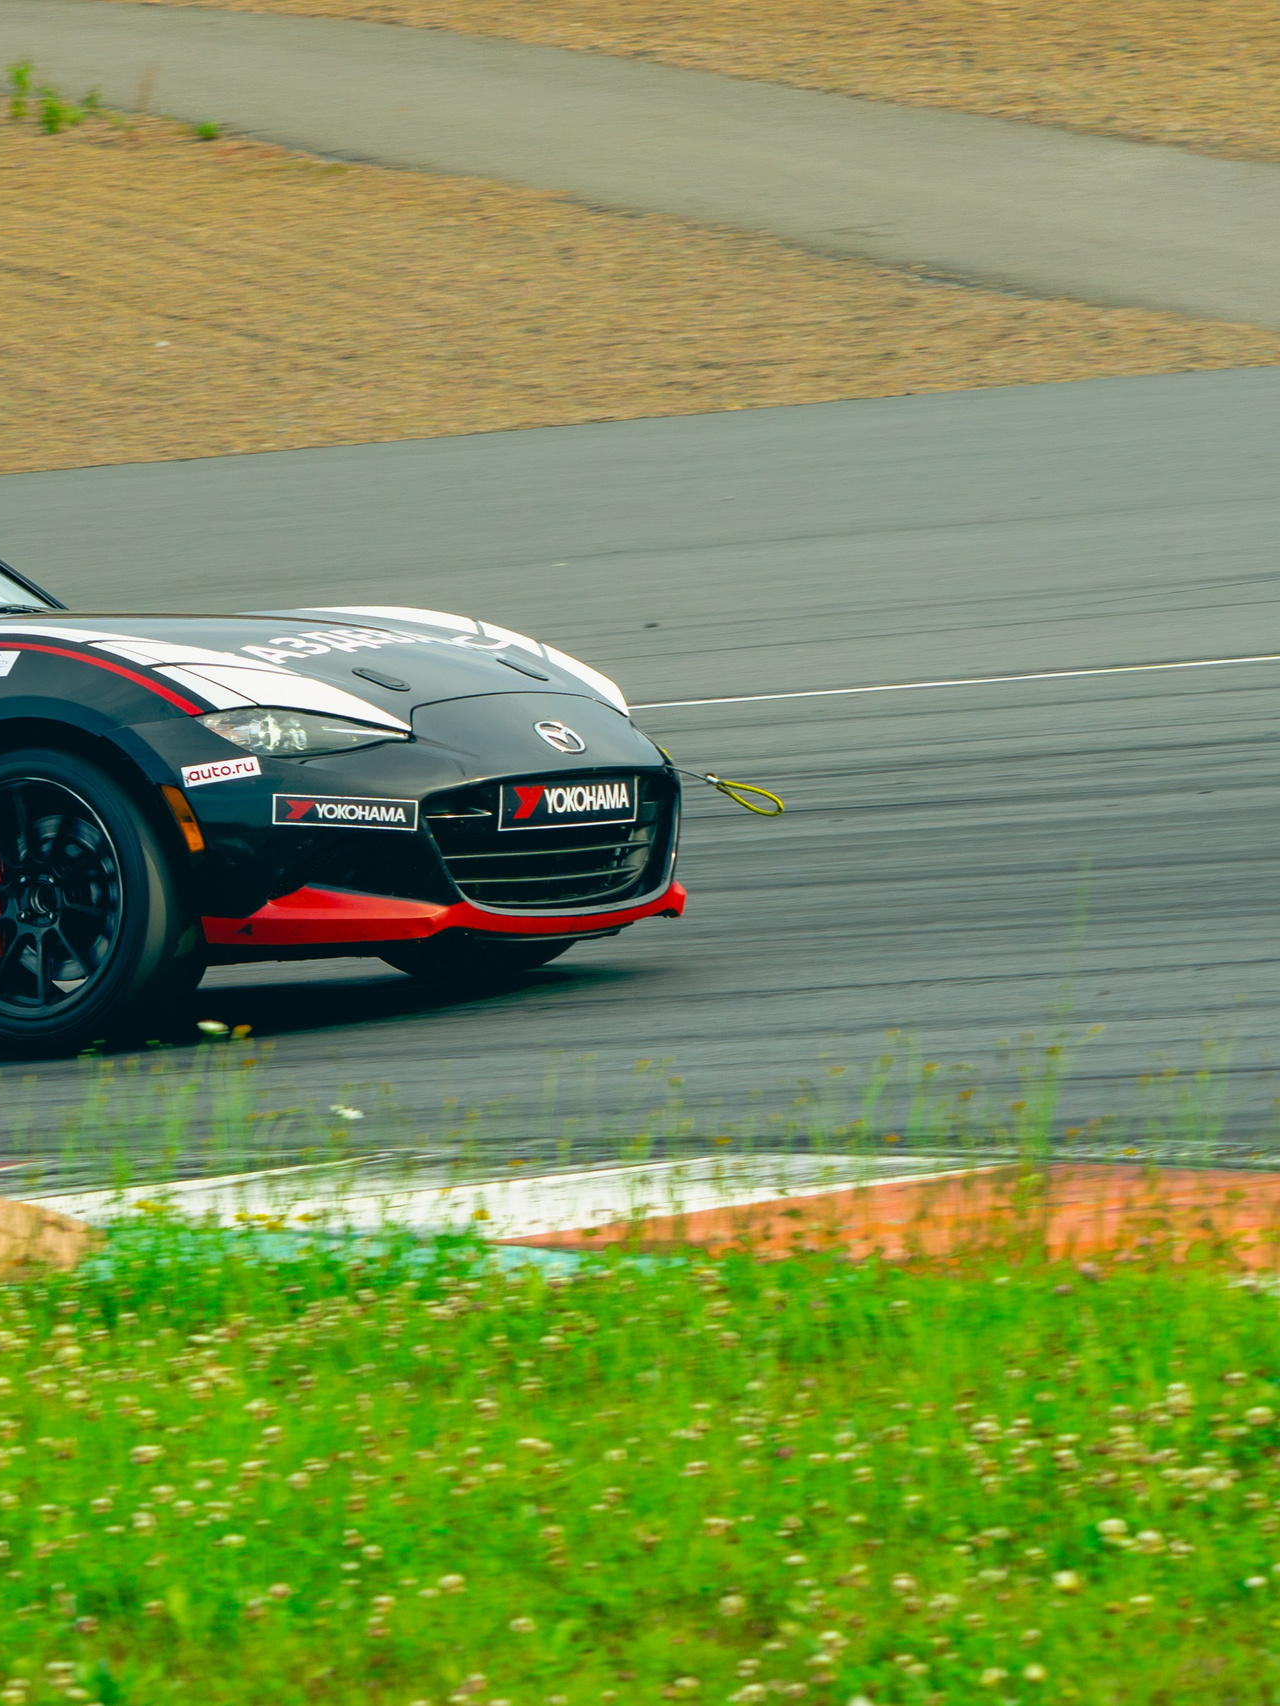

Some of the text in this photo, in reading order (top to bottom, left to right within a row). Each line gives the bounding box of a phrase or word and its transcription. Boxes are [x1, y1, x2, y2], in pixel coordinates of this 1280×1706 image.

[188, 759, 255, 782] auto.ru
[544, 783, 630, 814] YOKOHAMA
[315, 803, 407, 823] YOKOHAMA
